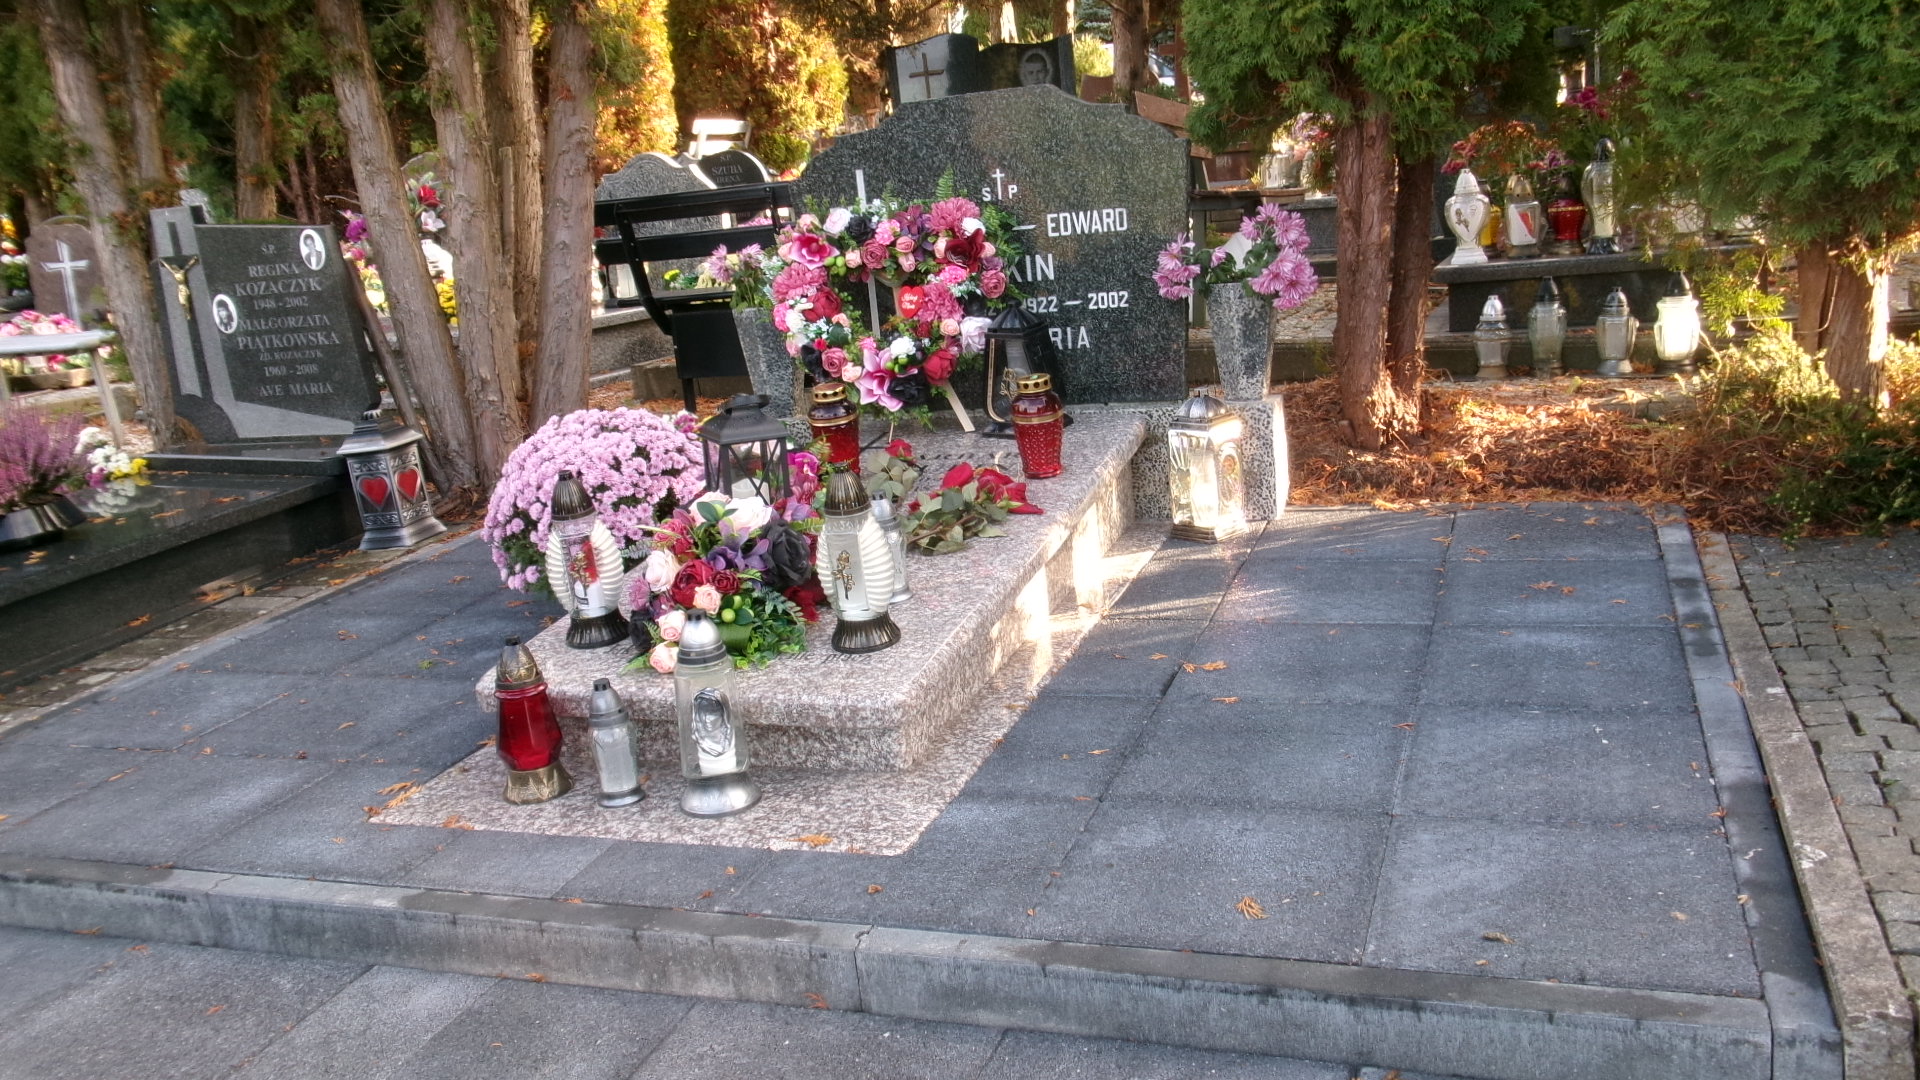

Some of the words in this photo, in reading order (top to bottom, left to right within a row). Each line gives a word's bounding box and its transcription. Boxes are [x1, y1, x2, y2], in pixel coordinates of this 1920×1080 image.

[1046, 207, 1128, 237] EDWARD
[248, 263, 300, 278] REGINA
[234, 278, 322, 297] KOZACZYK
[286, 296, 309, 308] 2002
[1088, 290, 1129, 310] 2002
[239, 314, 331, 332] MAŁGORZATA
[237, 331, 341, 352] PIĄTKOWSKA
[1049, 325, 1091, 350] RIA
[274, 349, 323, 360] KOZACZYK
[260, 384, 284, 397] AVE
[288, 381, 335, 396] MARIA
